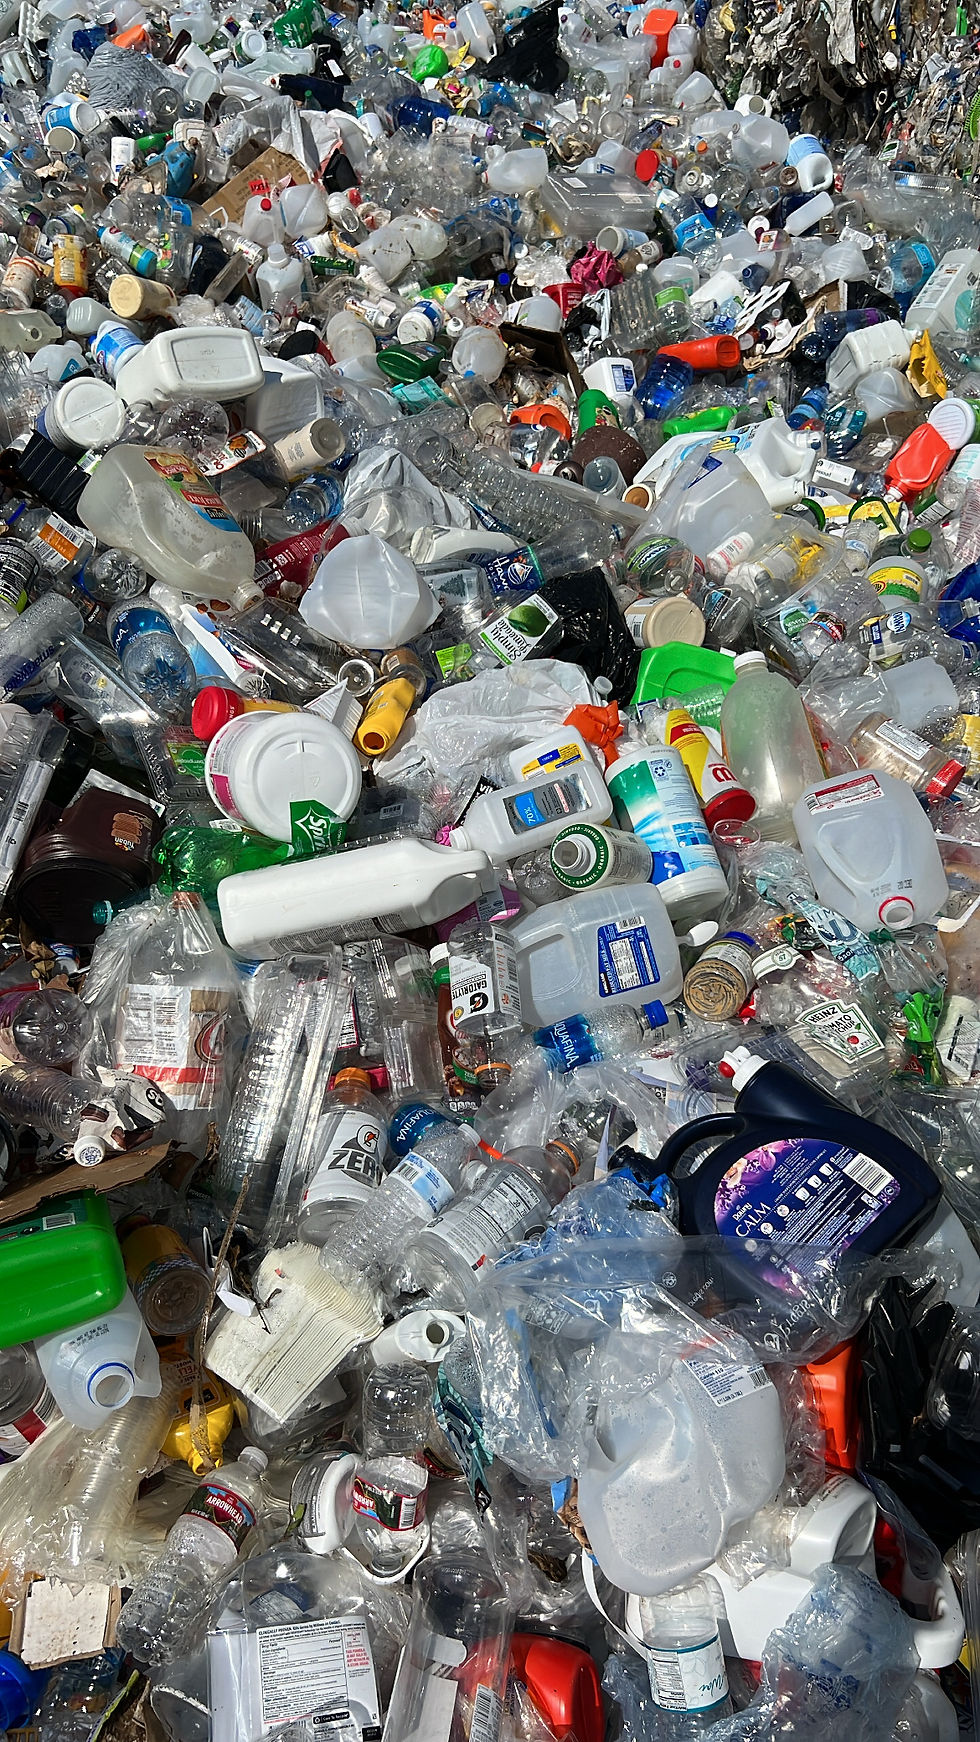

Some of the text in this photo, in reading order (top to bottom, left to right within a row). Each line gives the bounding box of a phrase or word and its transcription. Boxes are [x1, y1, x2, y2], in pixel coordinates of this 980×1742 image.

[490, 629, 520, 660] Simply
[497, 620, 530, 653] Limeade
[523, 806, 536, 824] 70%
[114, 837, 135, 850] Yuban
[576, 874, 597, 886] ORGANIC
[451, 979, 487, 1000] GATORLYTE
[808, 1007, 838, 1024] HEINZ
[511, 1172, 529, 1190] Nutrition
[732, 1201, 753, 1221] Downy
[735, 1201, 771, 1237] CALM
[206, 1495, 243, 1524] ARROWHEAD
